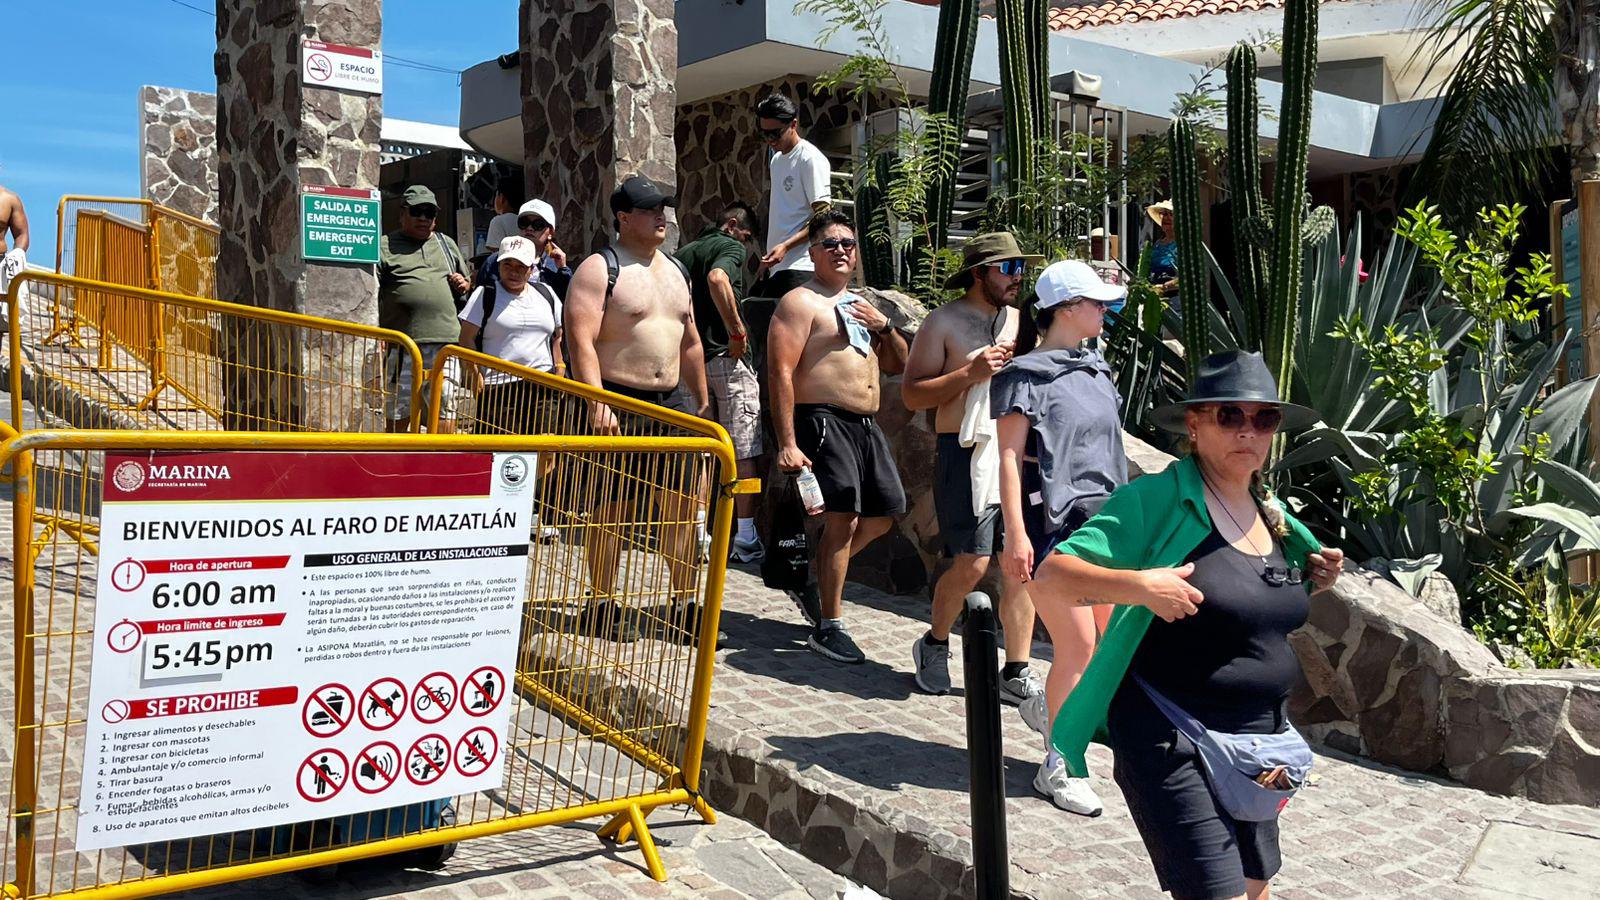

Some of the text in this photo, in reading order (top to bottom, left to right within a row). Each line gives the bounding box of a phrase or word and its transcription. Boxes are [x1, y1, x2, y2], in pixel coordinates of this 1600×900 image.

[340, 63, 375, 74] ESPACIO
[314, 200, 368, 214] SALIDA DE
[307, 213, 376, 228] EMERGENCIA
[309, 231, 374, 244] EMERGENCY
[331, 246, 353, 256] EXIT
[149, 465, 231, 479] MARINA
[123, 508, 516, 540] BIENVENIDOS AL FARO DE MAZATLÁN
[332, 547, 508, 565] USO GENERAL DE LAS INSTALACIONES
[170, 561, 252, 571] Hora de apertura
[328, 572, 354, 581] espacio
[152, 581, 276, 609] 6:00 am
[335, 587, 366, 597] personas
[408, 582, 450, 590] sorprendidas
[358, 594, 400, 603] ocasionando
[439, 588, 479, 596] instalaciones
[157, 623, 181, 631] Hora
[214, 619, 226, 628] de
[229, 617, 263, 628] ingreso
[330, 616, 360, 624] turnadas
[382, 610, 421, 620] autoridades
[307, 627, 326, 636] algún
[349, 623, 377, 632] deberán
[378, 621, 398, 629] cubrir
[410, 619, 430, 628] gastos
[317, 643, 349, 651] ASIPONA
[431, 633, 469, 641] responsable
[305, 653, 334, 663] perdidas
[363, 649, 386, 657] dentro
[393, 646, 410, 654] fuera
[431, 642, 471, 650] instalaciones
[146, 692, 260, 716] SE PROHIBE
[114, 730, 151, 741] Ingresar
[153, 725, 196, 736] alimentos
[205, 719, 256, 731] desechables
[113, 741, 149, 752] Ingresar
[152, 740, 168, 748] con
[170, 735, 211, 745] mascotas
[110, 763, 169, 776] Ambulantaje
[171, 760, 186, 770] y/o
[188, 756, 226, 766] comercio
[229, 751, 264, 762] informal
[112, 753, 149, 764] Ingresar
[151, 751, 167, 759] con
[169, 747, 209, 757] bicicletas
[109, 788, 151, 798] Encender
[153, 784, 185, 795] fogatas
[195, 778, 232, 789] braseros
[110, 778, 131, 788] Tirar
[133, 776, 163, 785] basura
[142, 797, 177, 807] bebidas
[179, 790, 228, 803] alcohólicas,
[230, 788, 256, 797] armas
[258, 784, 272, 794] y/o
[93, 802, 290, 833] 8. Uso de aparatos que emitan altos decibeles
